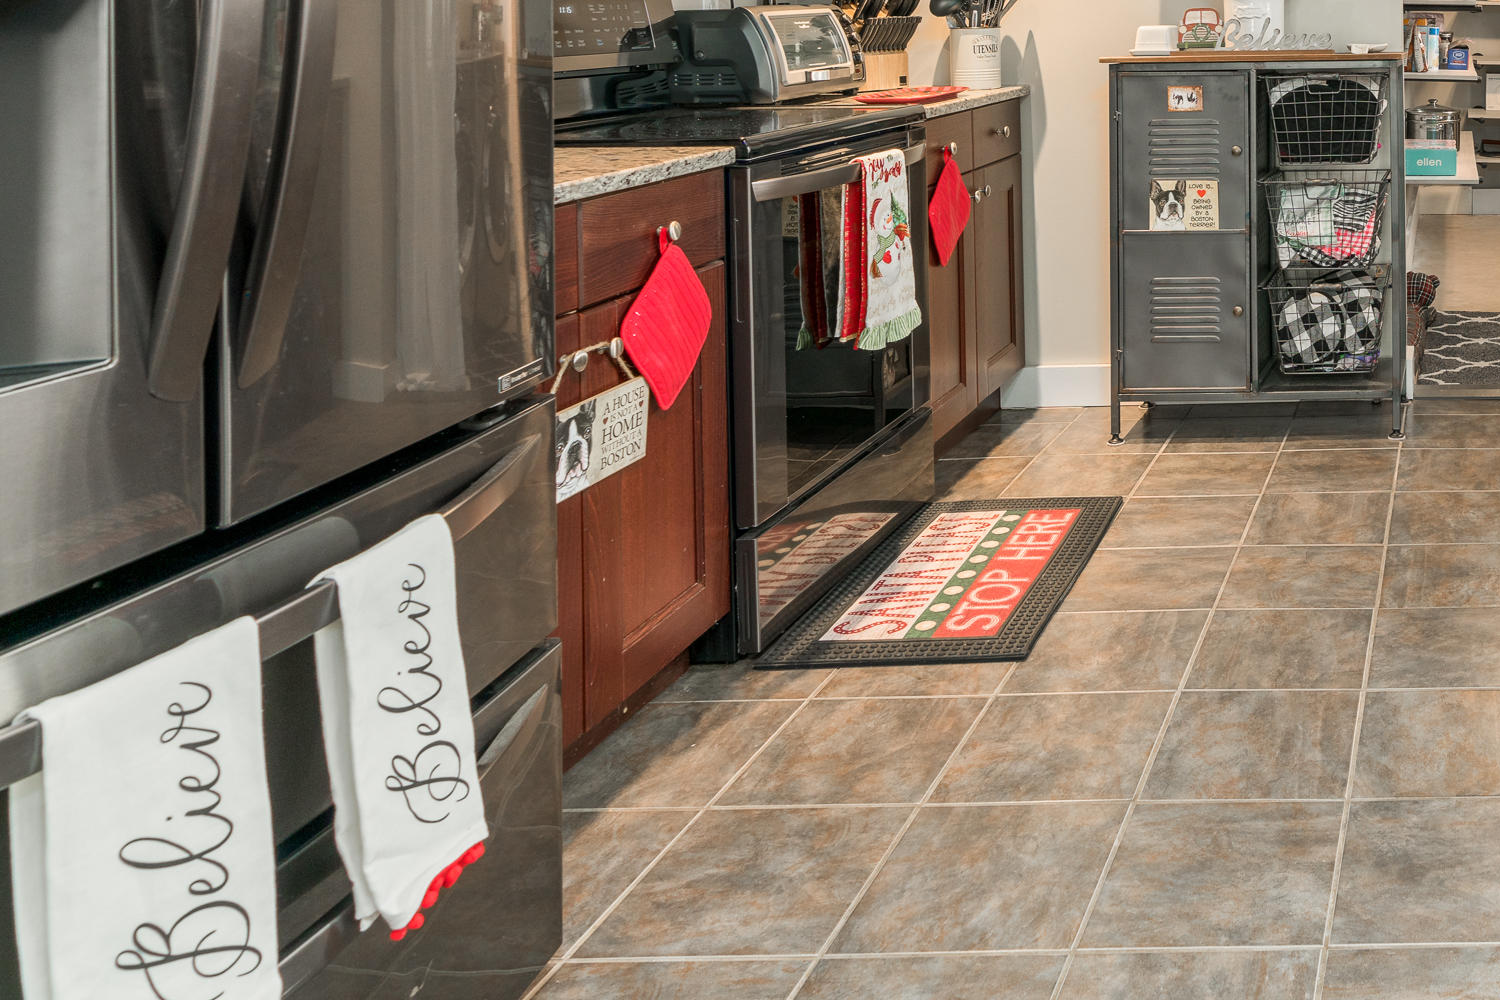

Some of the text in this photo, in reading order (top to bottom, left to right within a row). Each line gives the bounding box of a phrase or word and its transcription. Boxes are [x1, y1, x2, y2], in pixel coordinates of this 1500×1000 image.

[972, 43, 999, 55] UTENSILS
[1214, 17, 1335, 50] Believe
[1416, 157, 1442, 167] ellen
[603, 386, 645, 416] A HOUSE
[618, 406, 632, 419] NOT
[601, 411, 643, 446] HOME
[601, 429, 642, 454] WITHOUT A
[600, 438, 642, 470] BOSTON
[834, 513, 1000, 635] SANTA PLEASE
[945, 512, 1073, 631] STOP HERE
[377, 562, 470, 825] Believe
[114, 680, 263, 1000] Believe
